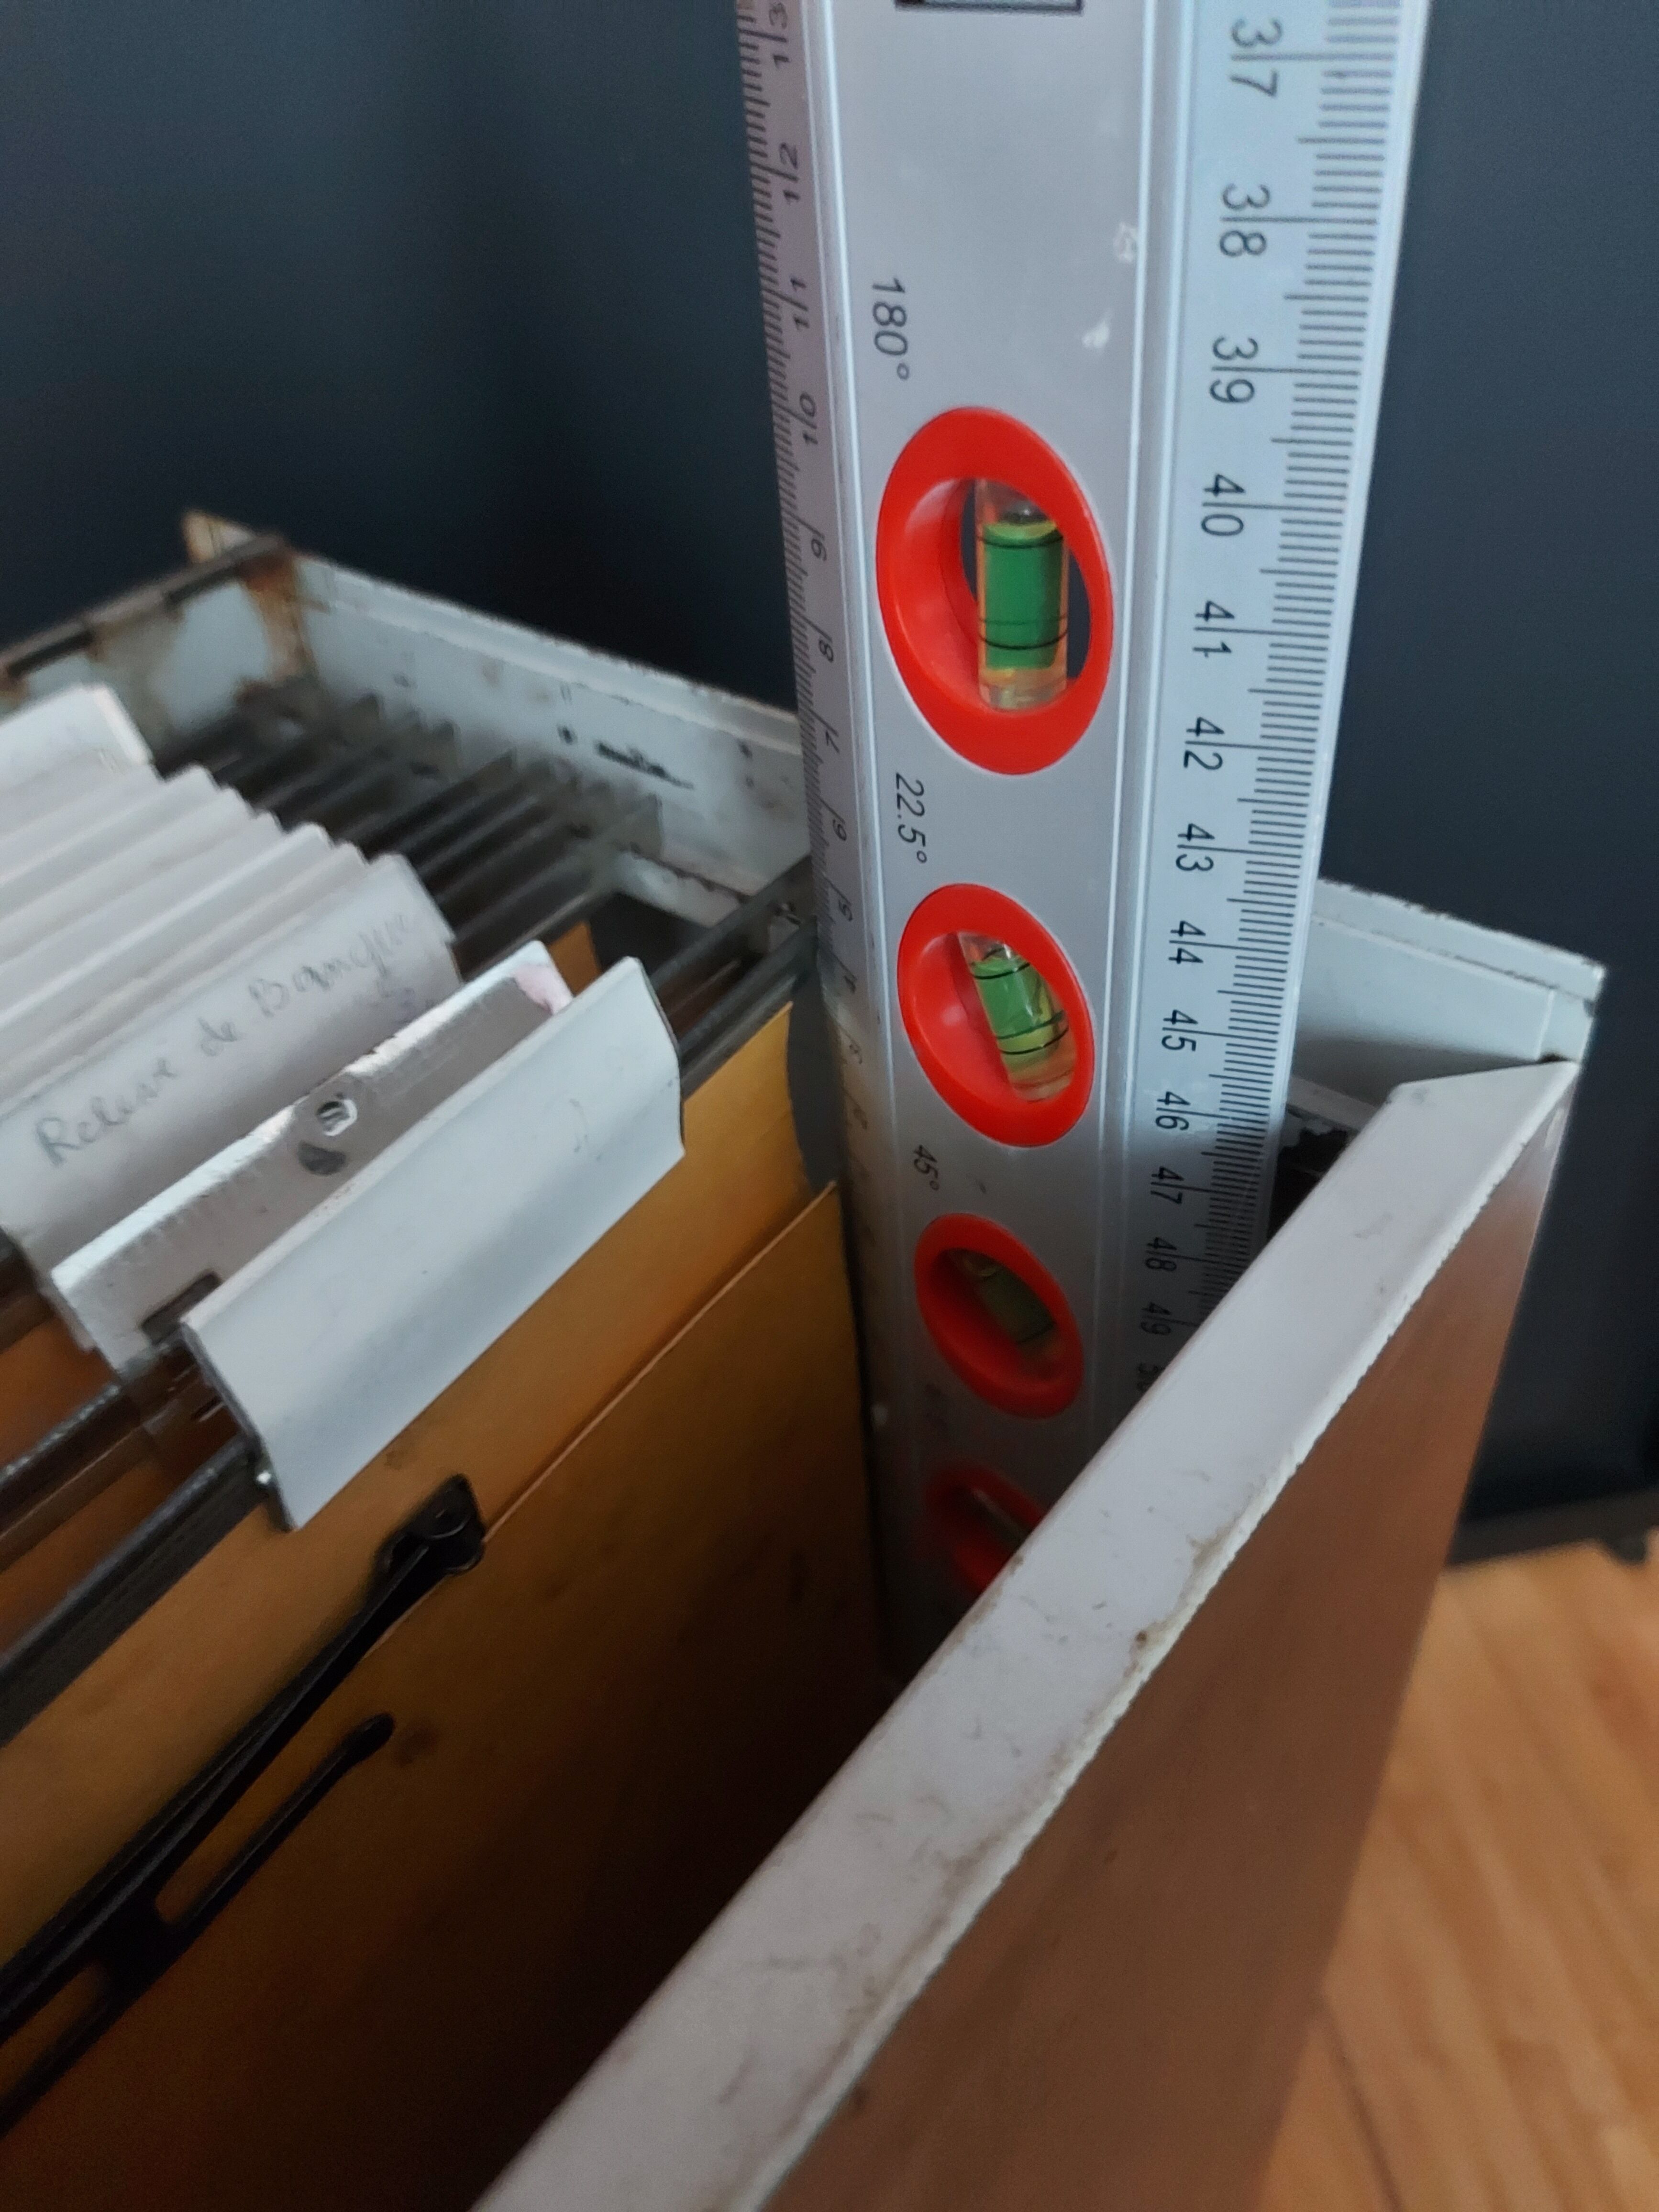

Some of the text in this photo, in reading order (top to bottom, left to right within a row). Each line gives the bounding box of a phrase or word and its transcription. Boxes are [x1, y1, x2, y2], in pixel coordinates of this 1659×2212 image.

[1230, 18, 1283, 97] 37
[779, 143, 800, 205] 12
[1218, 183, 1271, 258] 38
[790, 276, 809, 331] 11
[872, 277, 910, 381] 180°
[1210, 336, 1259, 404] 39
[799, 392, 818, 446] 10
[1201, 474, 1245, 536] 40
[818, 639, 834, 663] 8
[1193, 600, 1235, 655] 41
[1183, 717, 1224, 770] 42
[896, 772, 927, 864] 22.5°
[1175, 823, 1215, 871] 43
[1168, 920, 1206, 964] 44
[1161, 1009, 1198, 1051] 45
[1155, 1091, 1191, 1130] 46
[914, 1145, 940, 1191] 45°
[1150, 1166, 1184, 1204] 47
[1145, 1237, 1177, 1272] 48
[1140, 1302, 1172, 1336] 49
